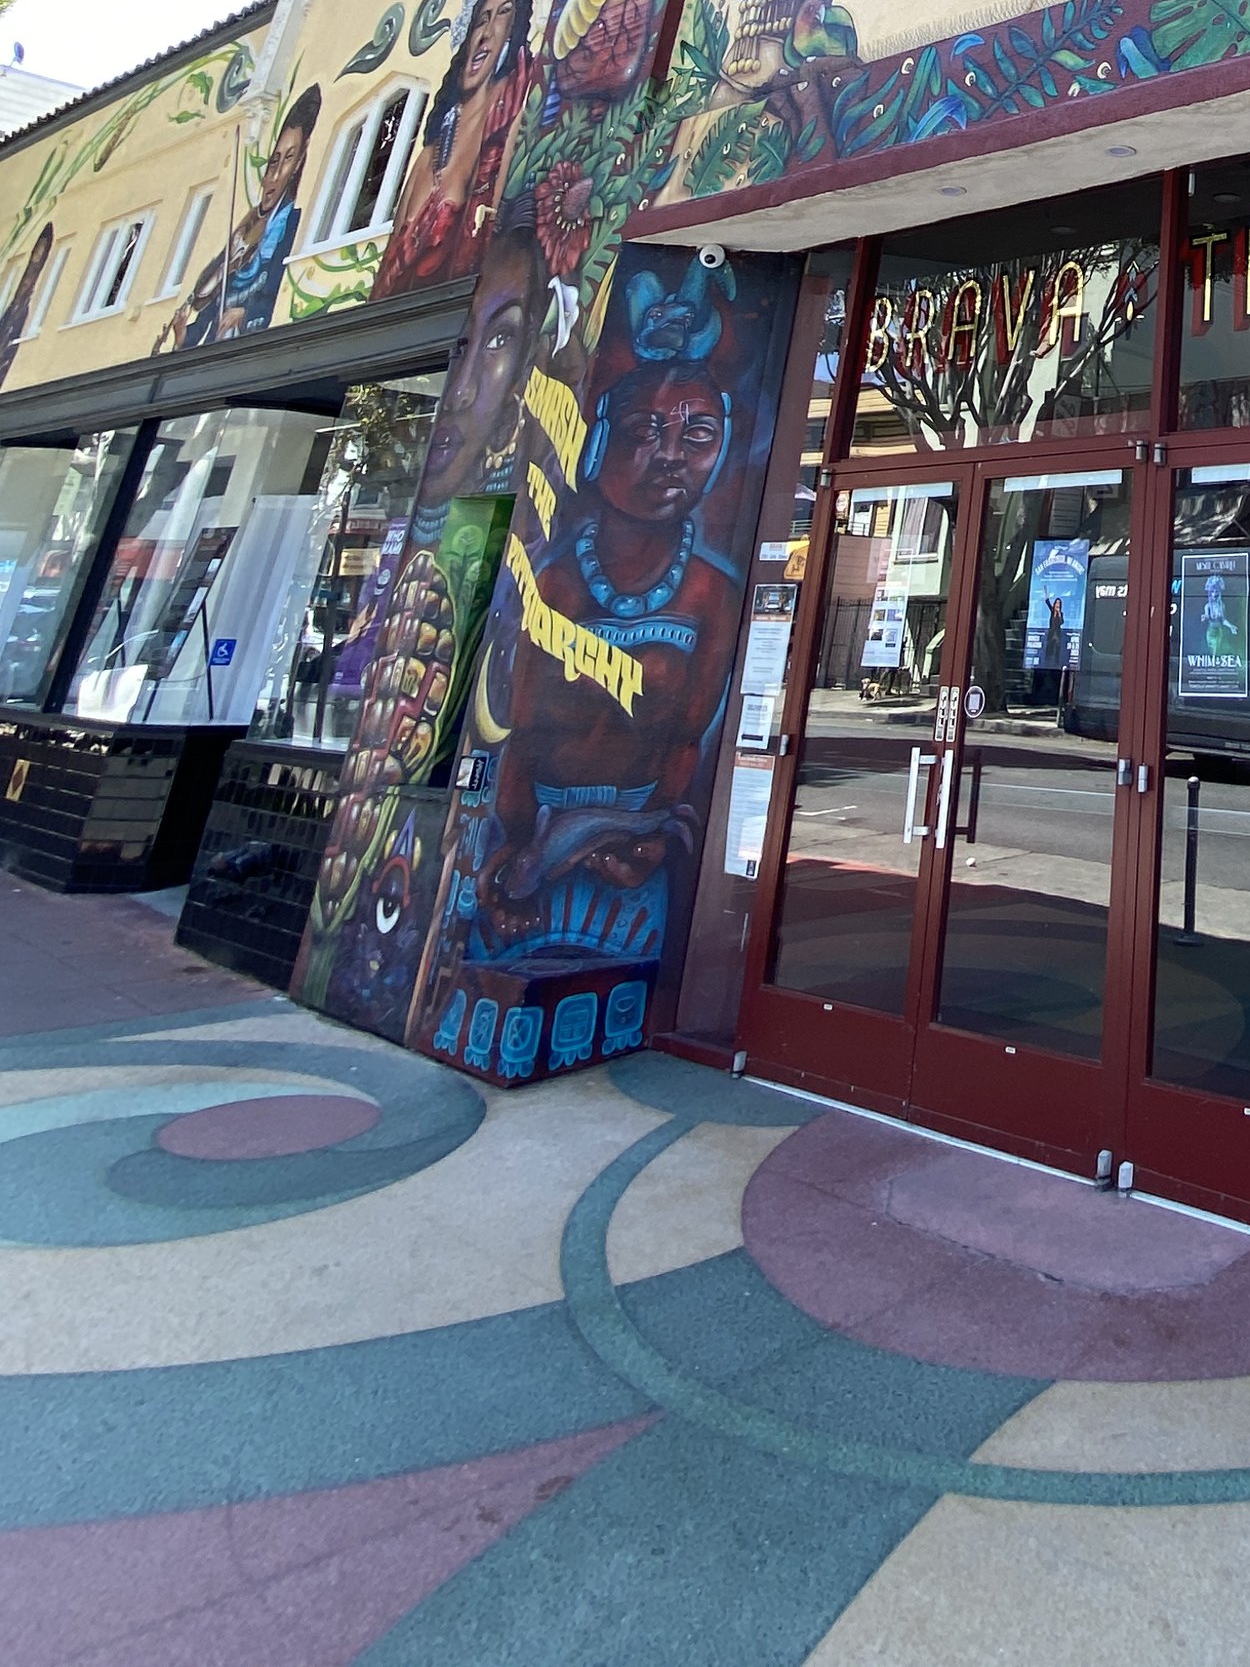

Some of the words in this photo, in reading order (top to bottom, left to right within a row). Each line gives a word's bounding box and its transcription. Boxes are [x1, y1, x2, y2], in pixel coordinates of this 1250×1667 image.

[865, 260, 1085, 374] BRAVA
[524, 365, 588, 494] SMASH
[526, 461, 557, 542] THE
[506, 533, 644, 718] PATRIARCHY
